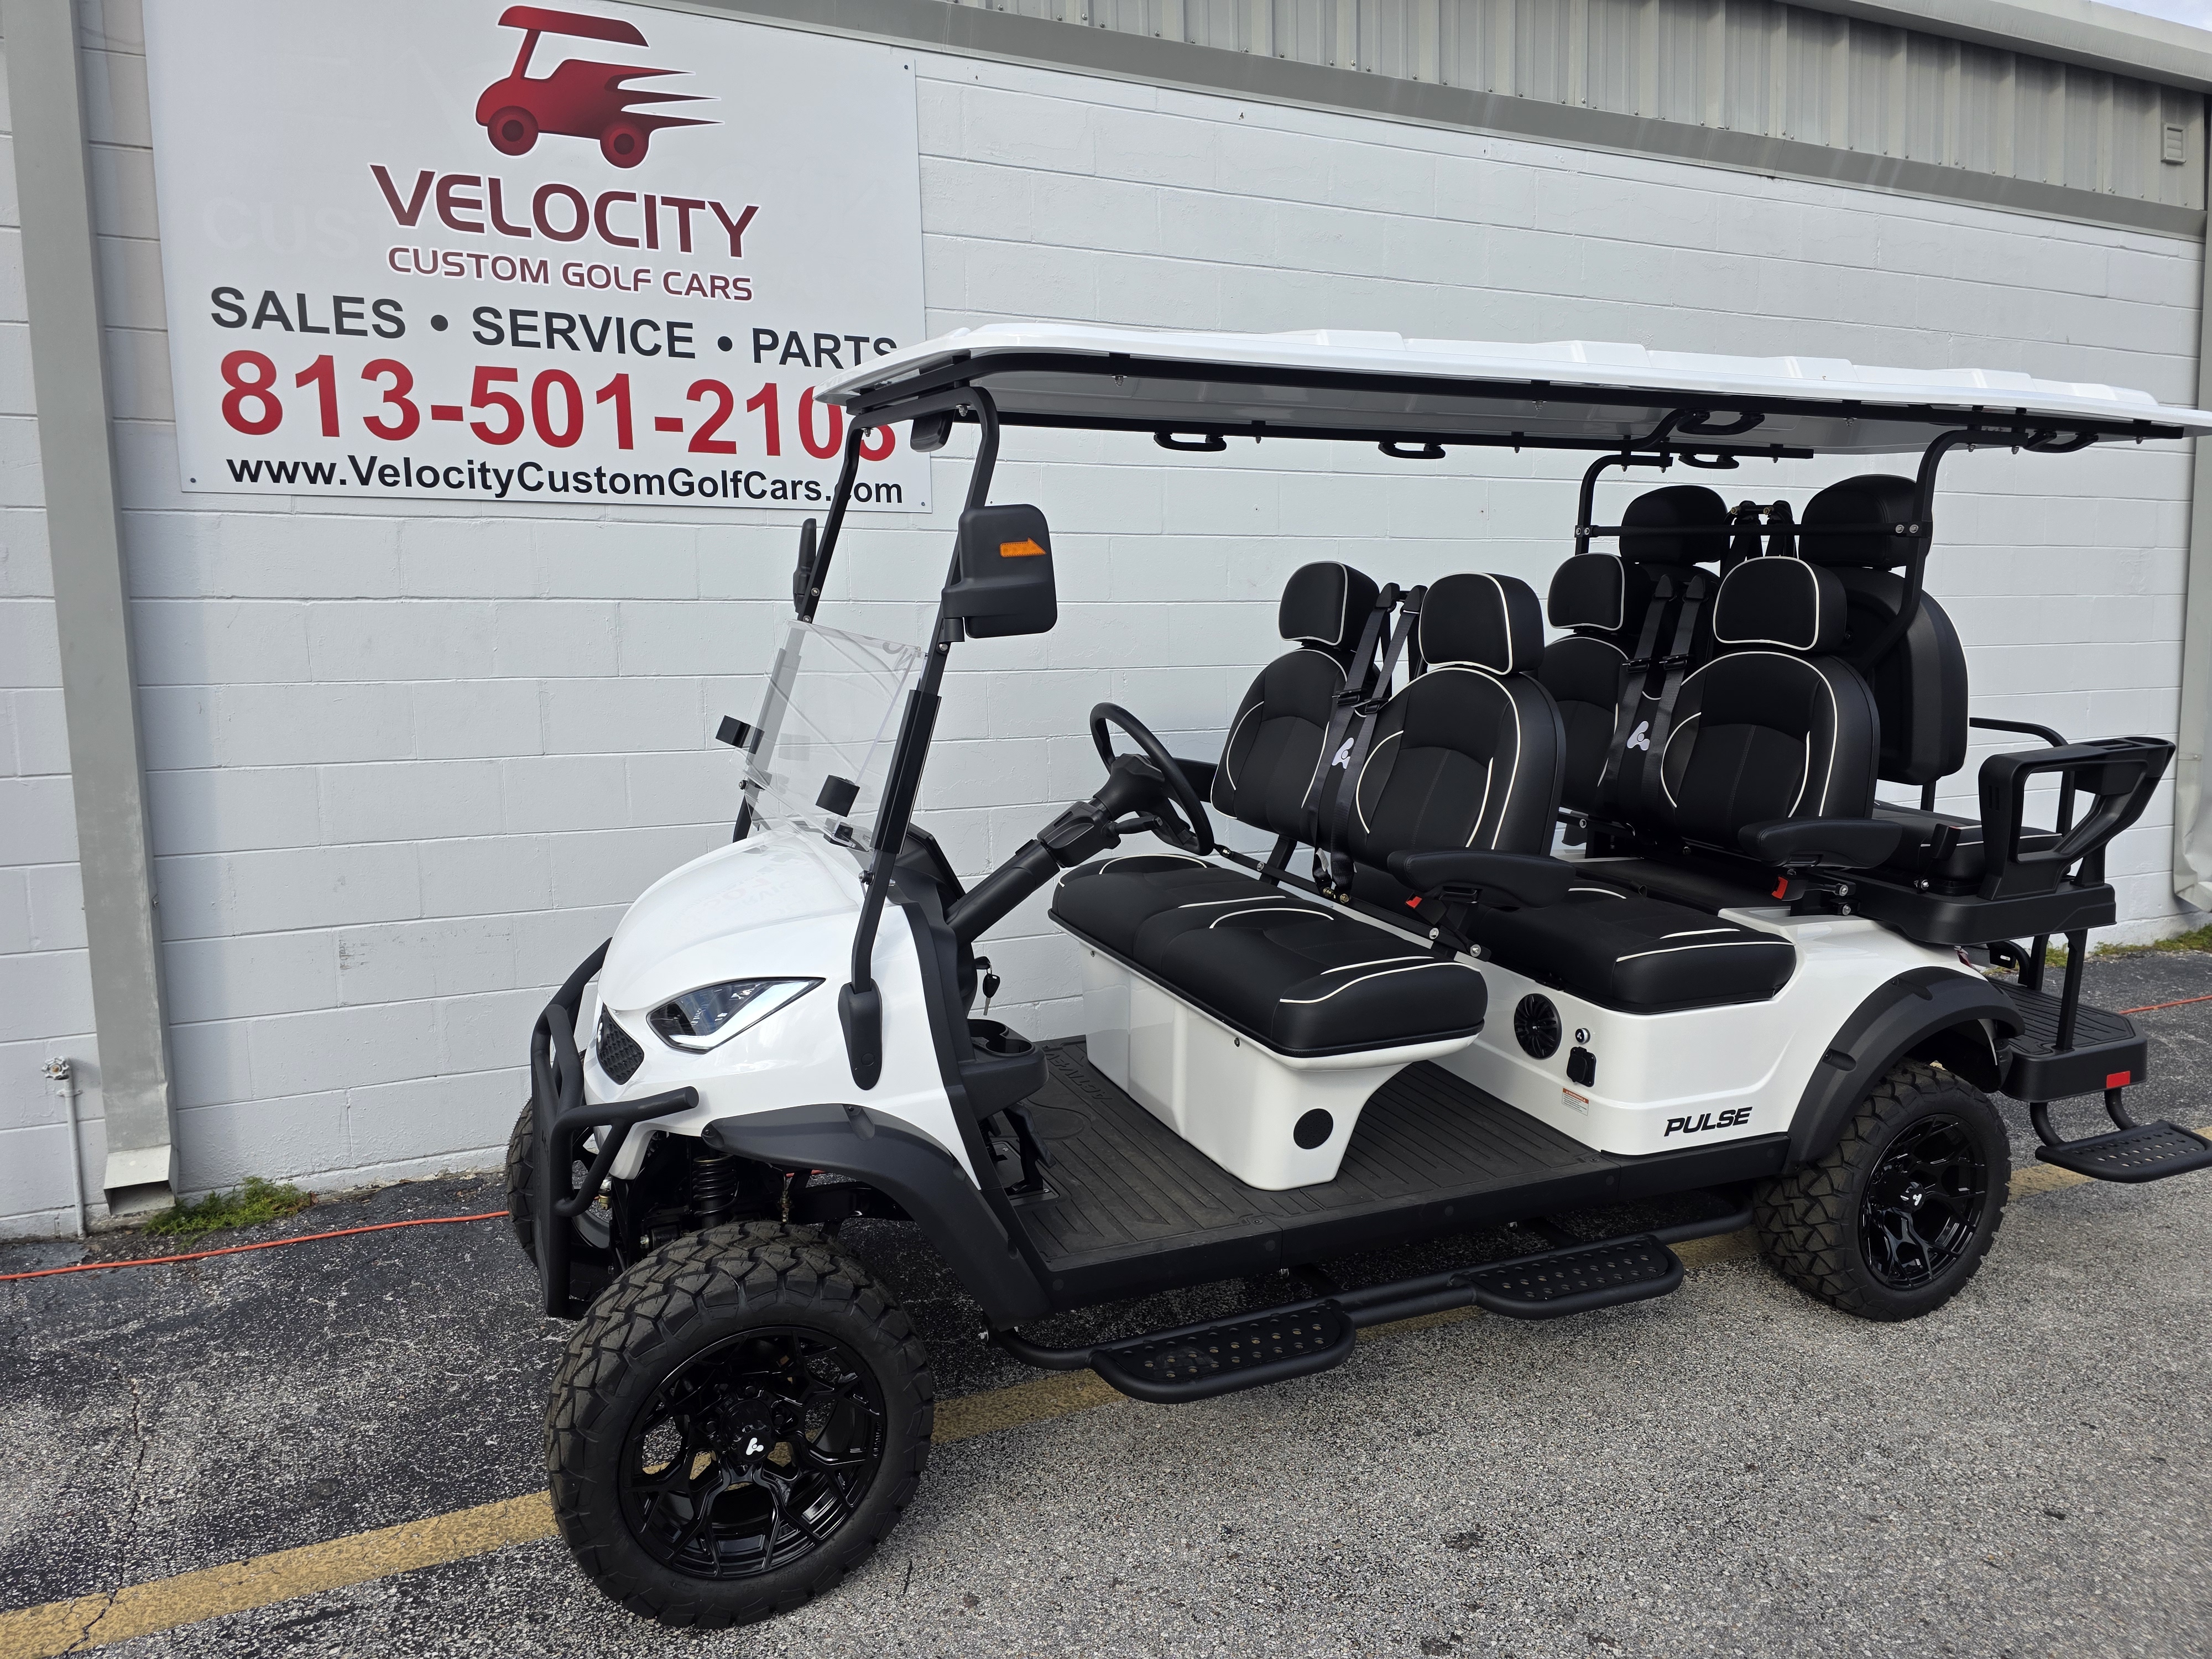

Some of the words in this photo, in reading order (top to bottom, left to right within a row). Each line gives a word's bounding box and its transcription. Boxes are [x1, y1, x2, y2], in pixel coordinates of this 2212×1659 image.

[369, 164, 760, 258] VELOCITY
[388, 247, 550, 285] CUSTOM
[562, 262, 652, 292] GOLF
[662, 271, 753, 301] CARS
[211, 286, 406, 339] SALES
[472, 306, 696, 359] SERVICE
[226, 455, 902, 504] www.VelocityCustomGolfCars.om
[1663, 1106, 1753, 1137] PULSE
